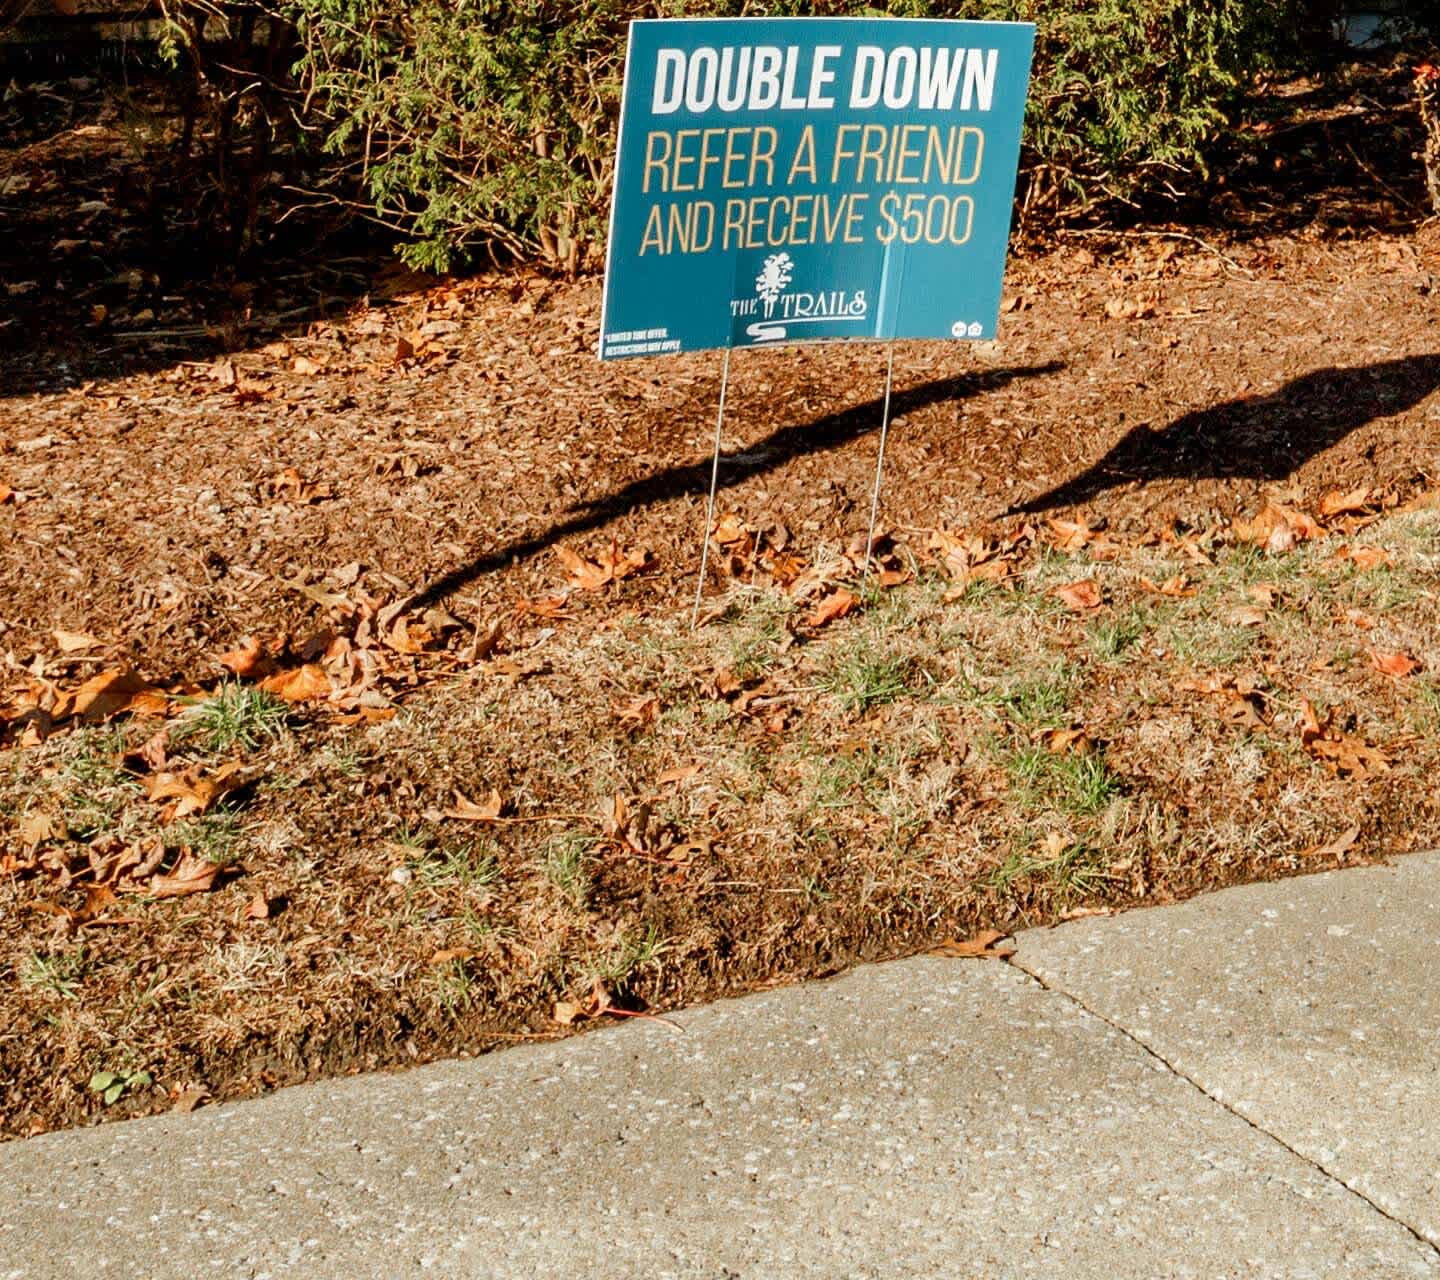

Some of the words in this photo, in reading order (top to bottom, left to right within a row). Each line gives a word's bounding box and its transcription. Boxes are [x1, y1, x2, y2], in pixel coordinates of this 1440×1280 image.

[651, 46, 842, 114] DOUBLE
[849, 46, 999, 112] DOWN
[642, 126, 778, 193] REFER
[787, 125, 817, 185] A
[831, 125, 985, 185] FRIEND
[639, 200, 714, 257] AND
[722, 192, 869, 250] RECEIVE
[876, 190, 974, 246] $500
[730, 298, 757, 316] THE
[780, 289, 868, 318] TRAILS
